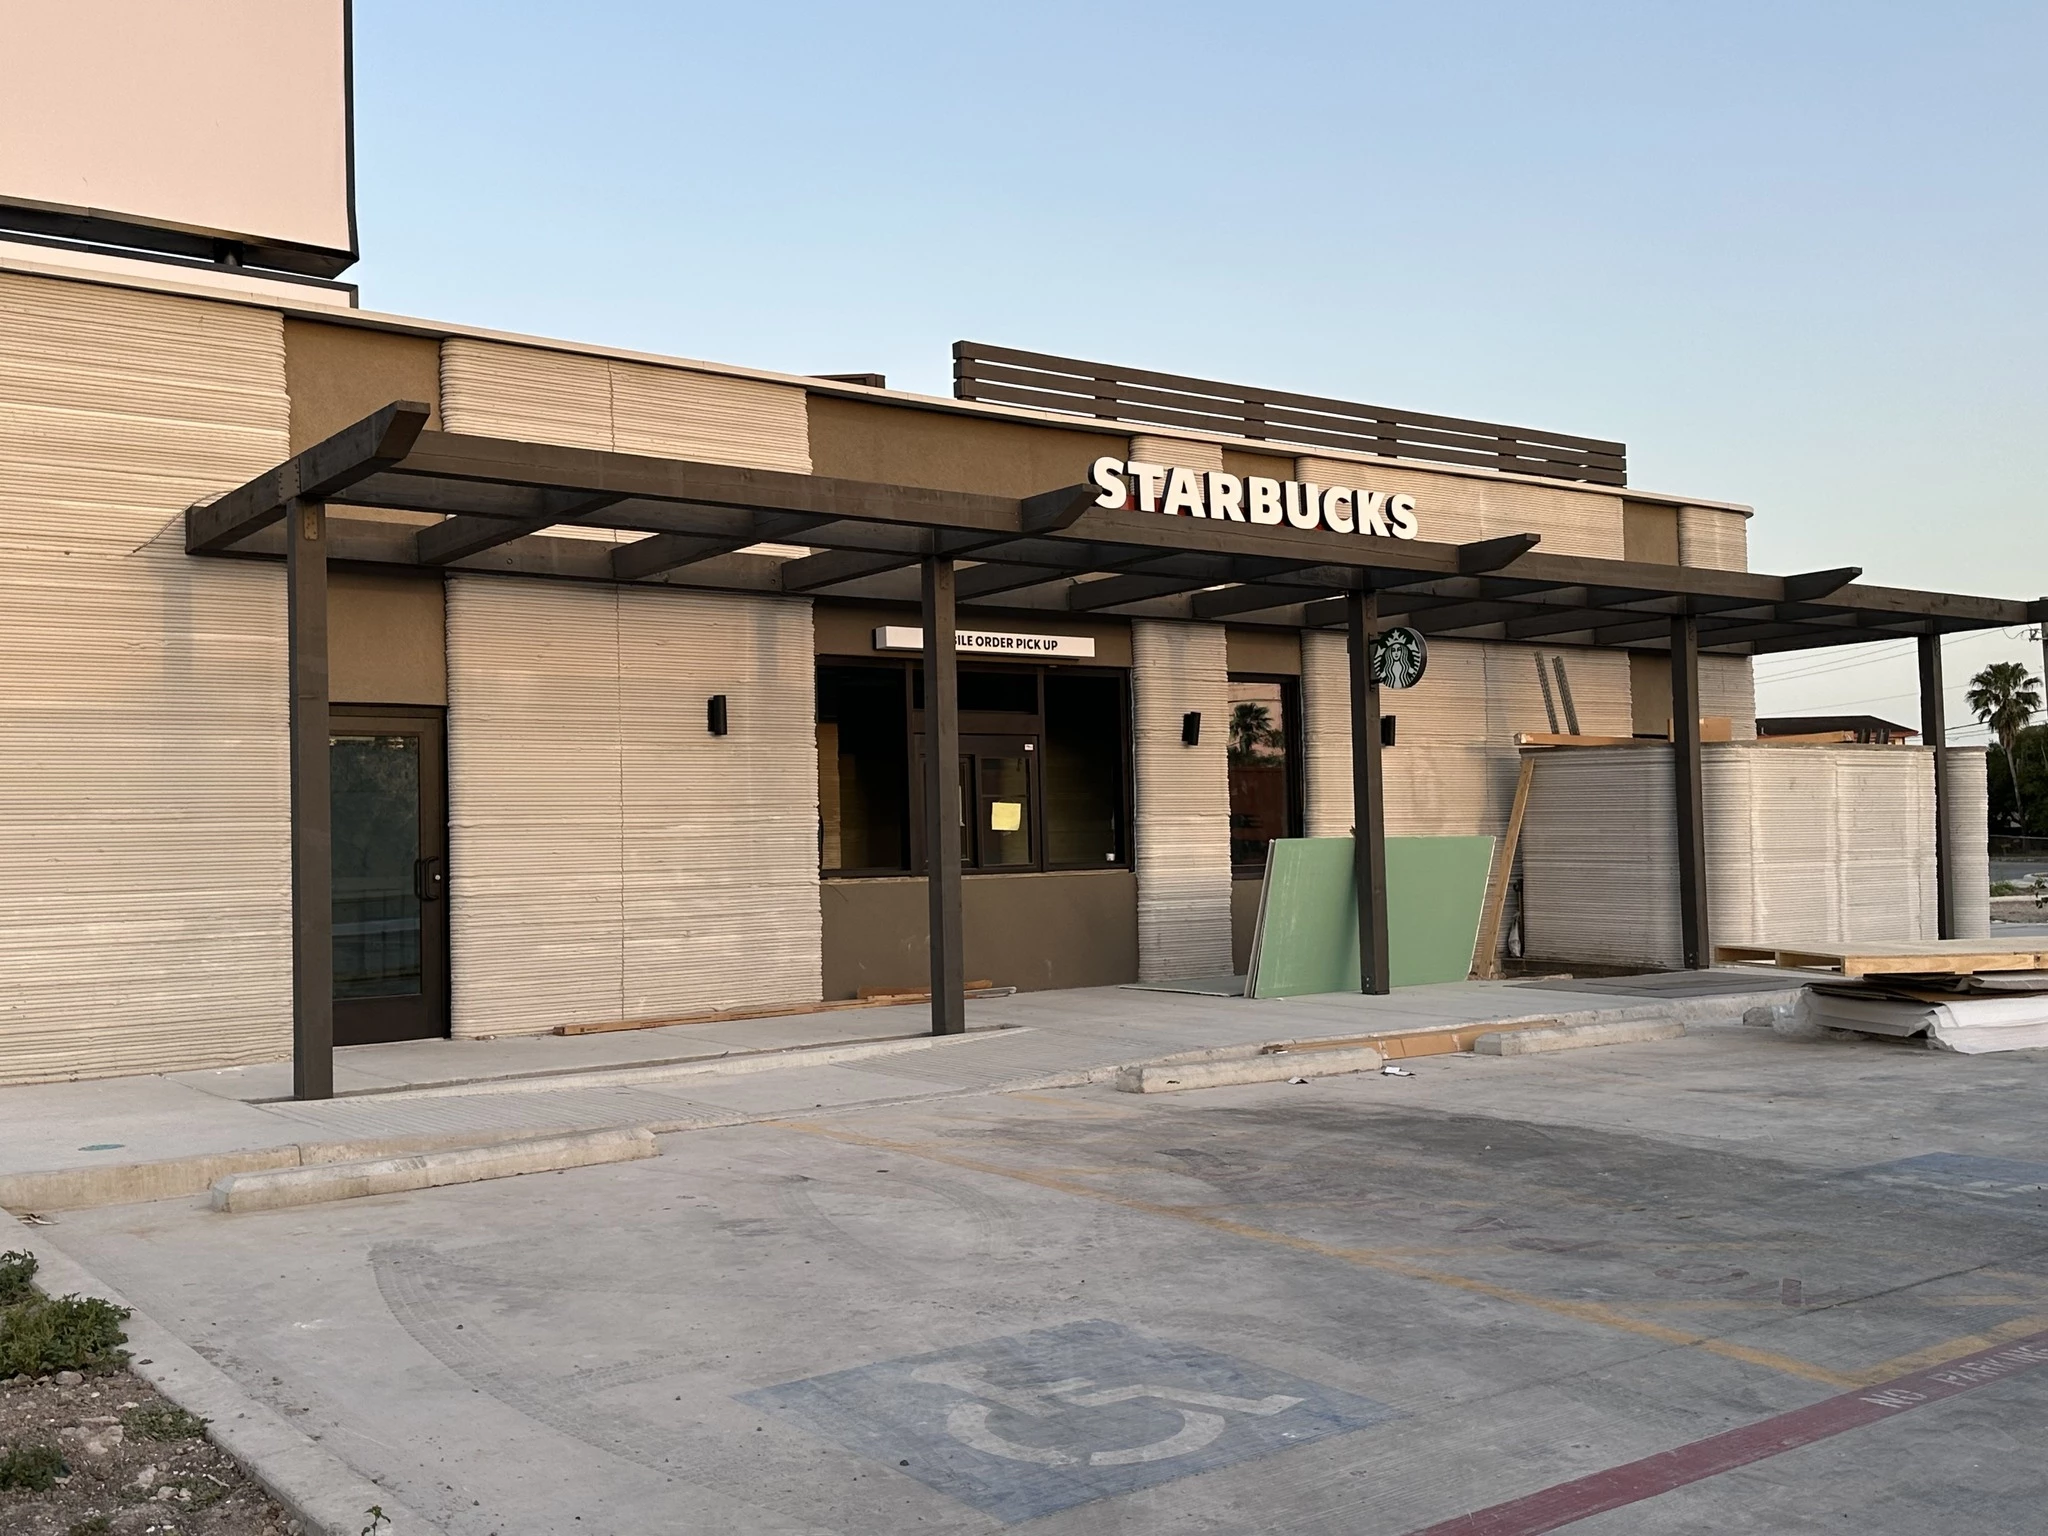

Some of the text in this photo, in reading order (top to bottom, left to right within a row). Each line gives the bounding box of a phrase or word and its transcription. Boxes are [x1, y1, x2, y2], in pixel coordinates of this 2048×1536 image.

[1091, 457, 1419, 540] STARBUCKS
[954, 634, 1058, 651] ILE ORDER PICK UP
[1858, 1389, 1928, 1409] NO
